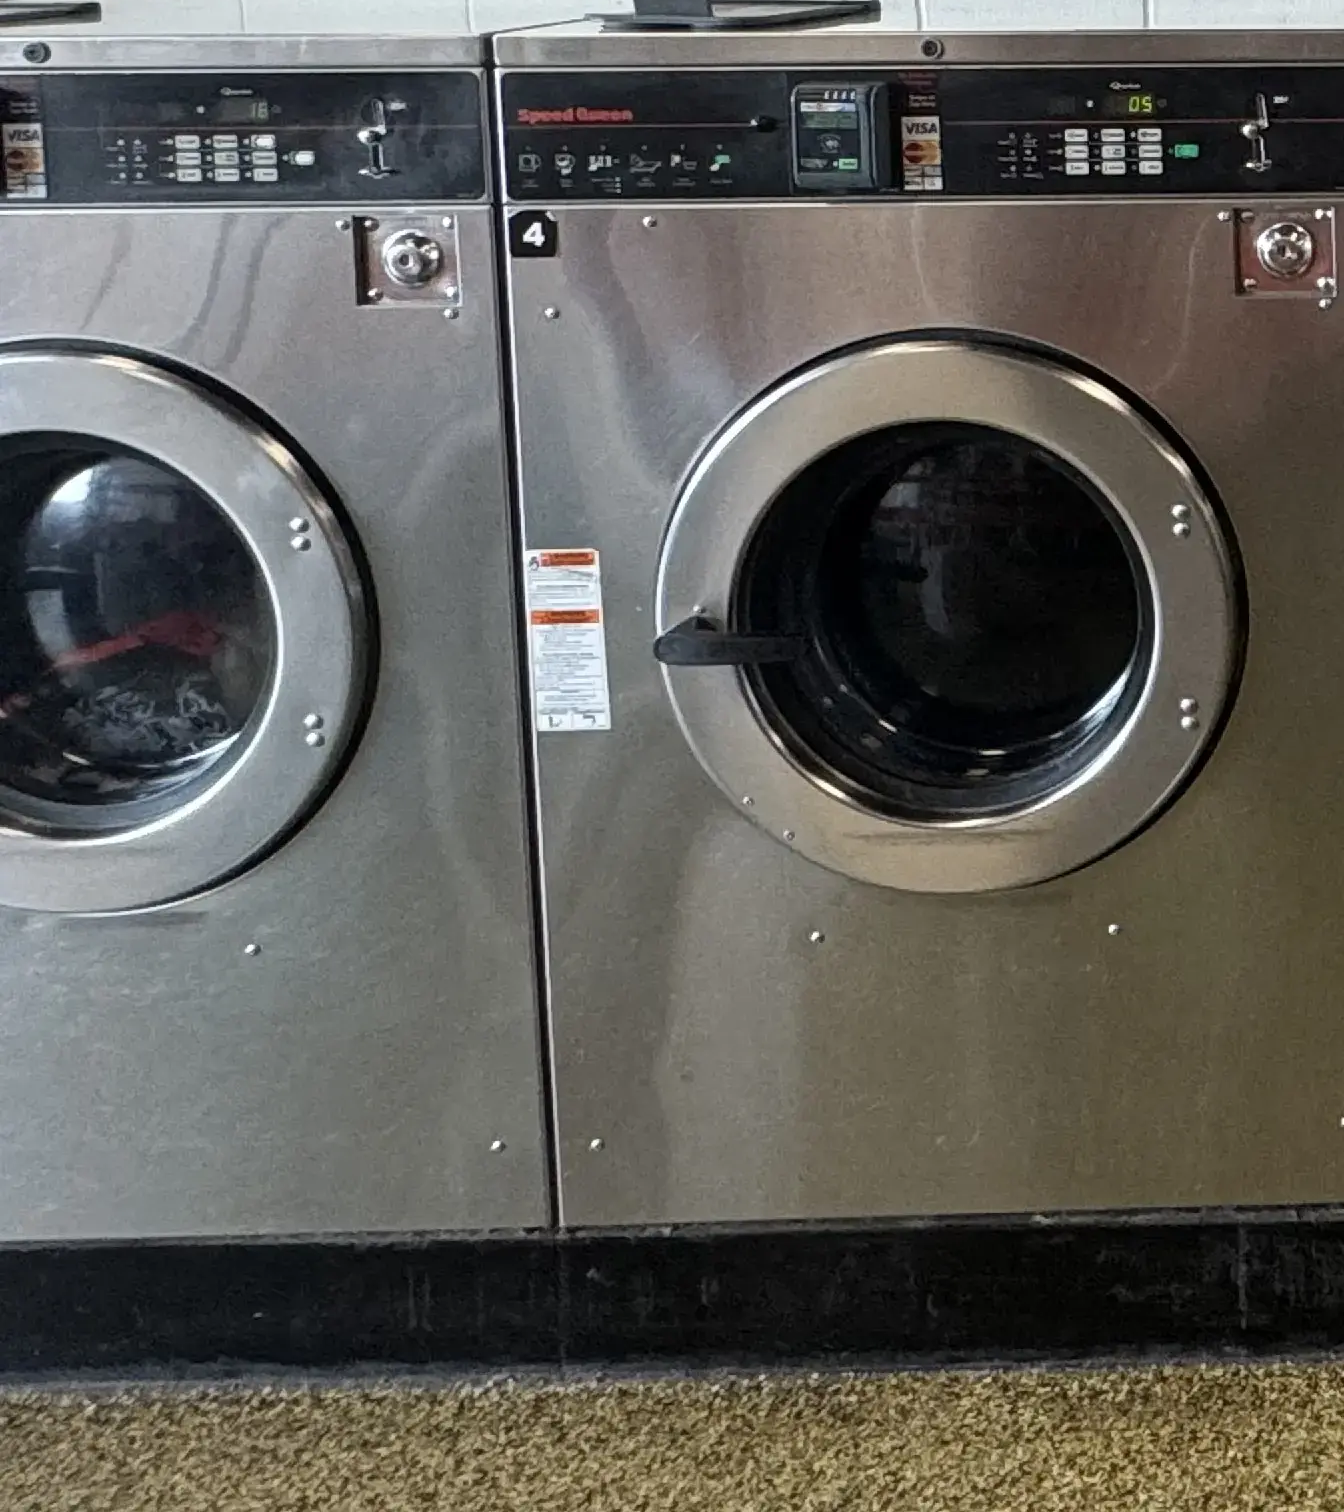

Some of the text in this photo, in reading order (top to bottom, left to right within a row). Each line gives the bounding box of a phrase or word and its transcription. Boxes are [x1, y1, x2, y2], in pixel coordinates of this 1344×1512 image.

[1128, 95, 1153, 113] 05
[7, 129, 40, 142] VISA
[905, 122, 938, 135] VISA
[522, 221, 546, 247] 4
